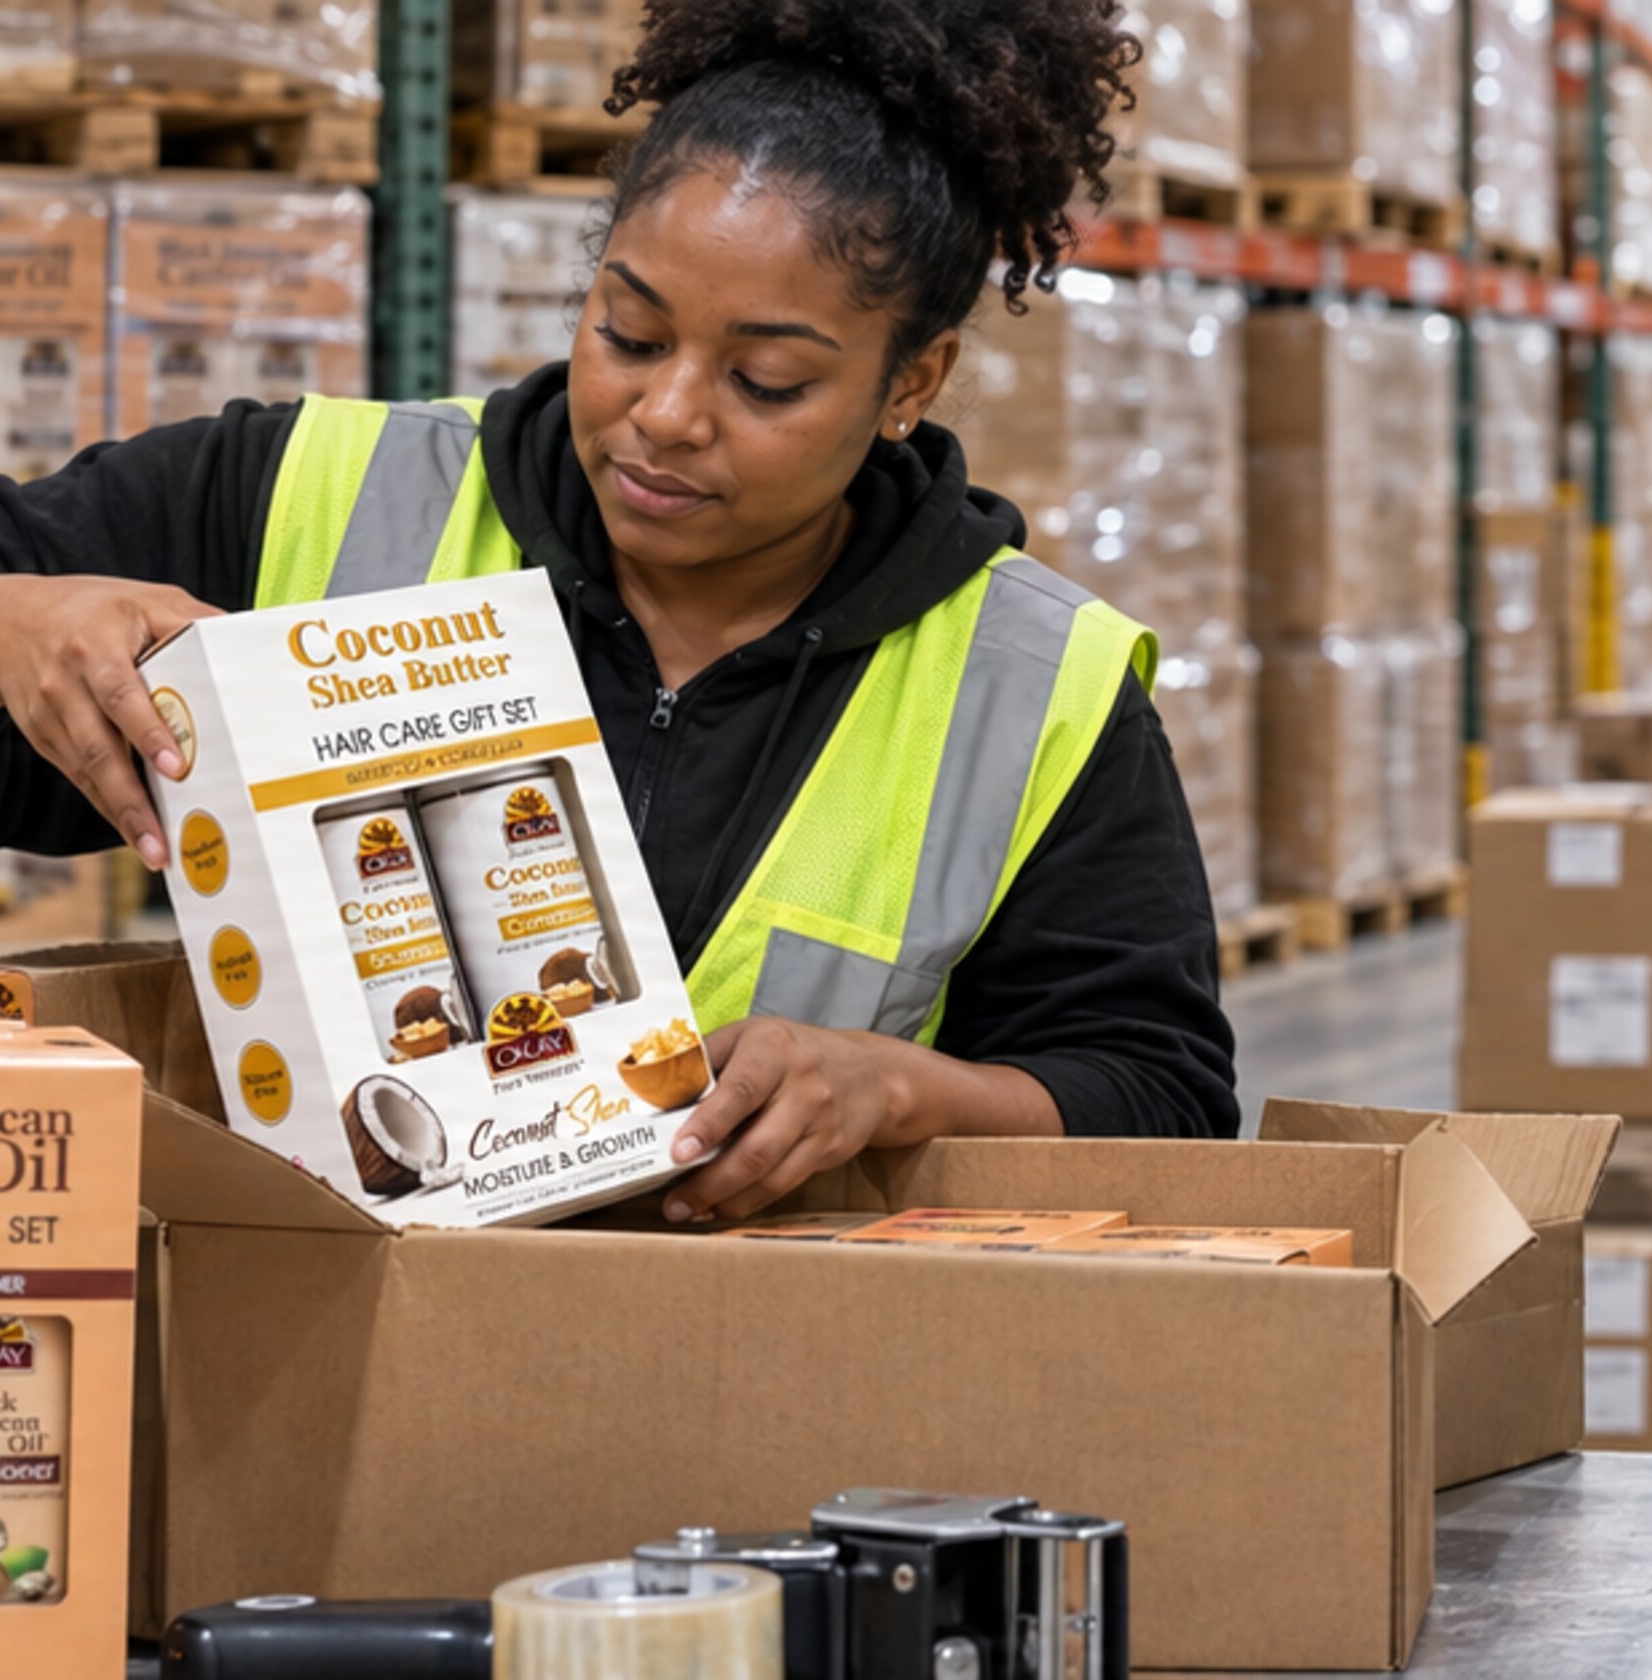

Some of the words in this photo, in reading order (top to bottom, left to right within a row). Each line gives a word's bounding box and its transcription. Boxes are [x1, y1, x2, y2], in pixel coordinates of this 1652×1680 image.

[287, 600, 505, 668] Coconut
[307, 672, 397, 710] Shea
[402, 653, 511, 691] Butter
[312, 727, 374, 761] HAIR
[379, 714, 446, 748] CARE
[449, 704, 497, 734] GIFT
[502, 697, 538, 724] SET
[8, 1216, 59, 1244] SET
